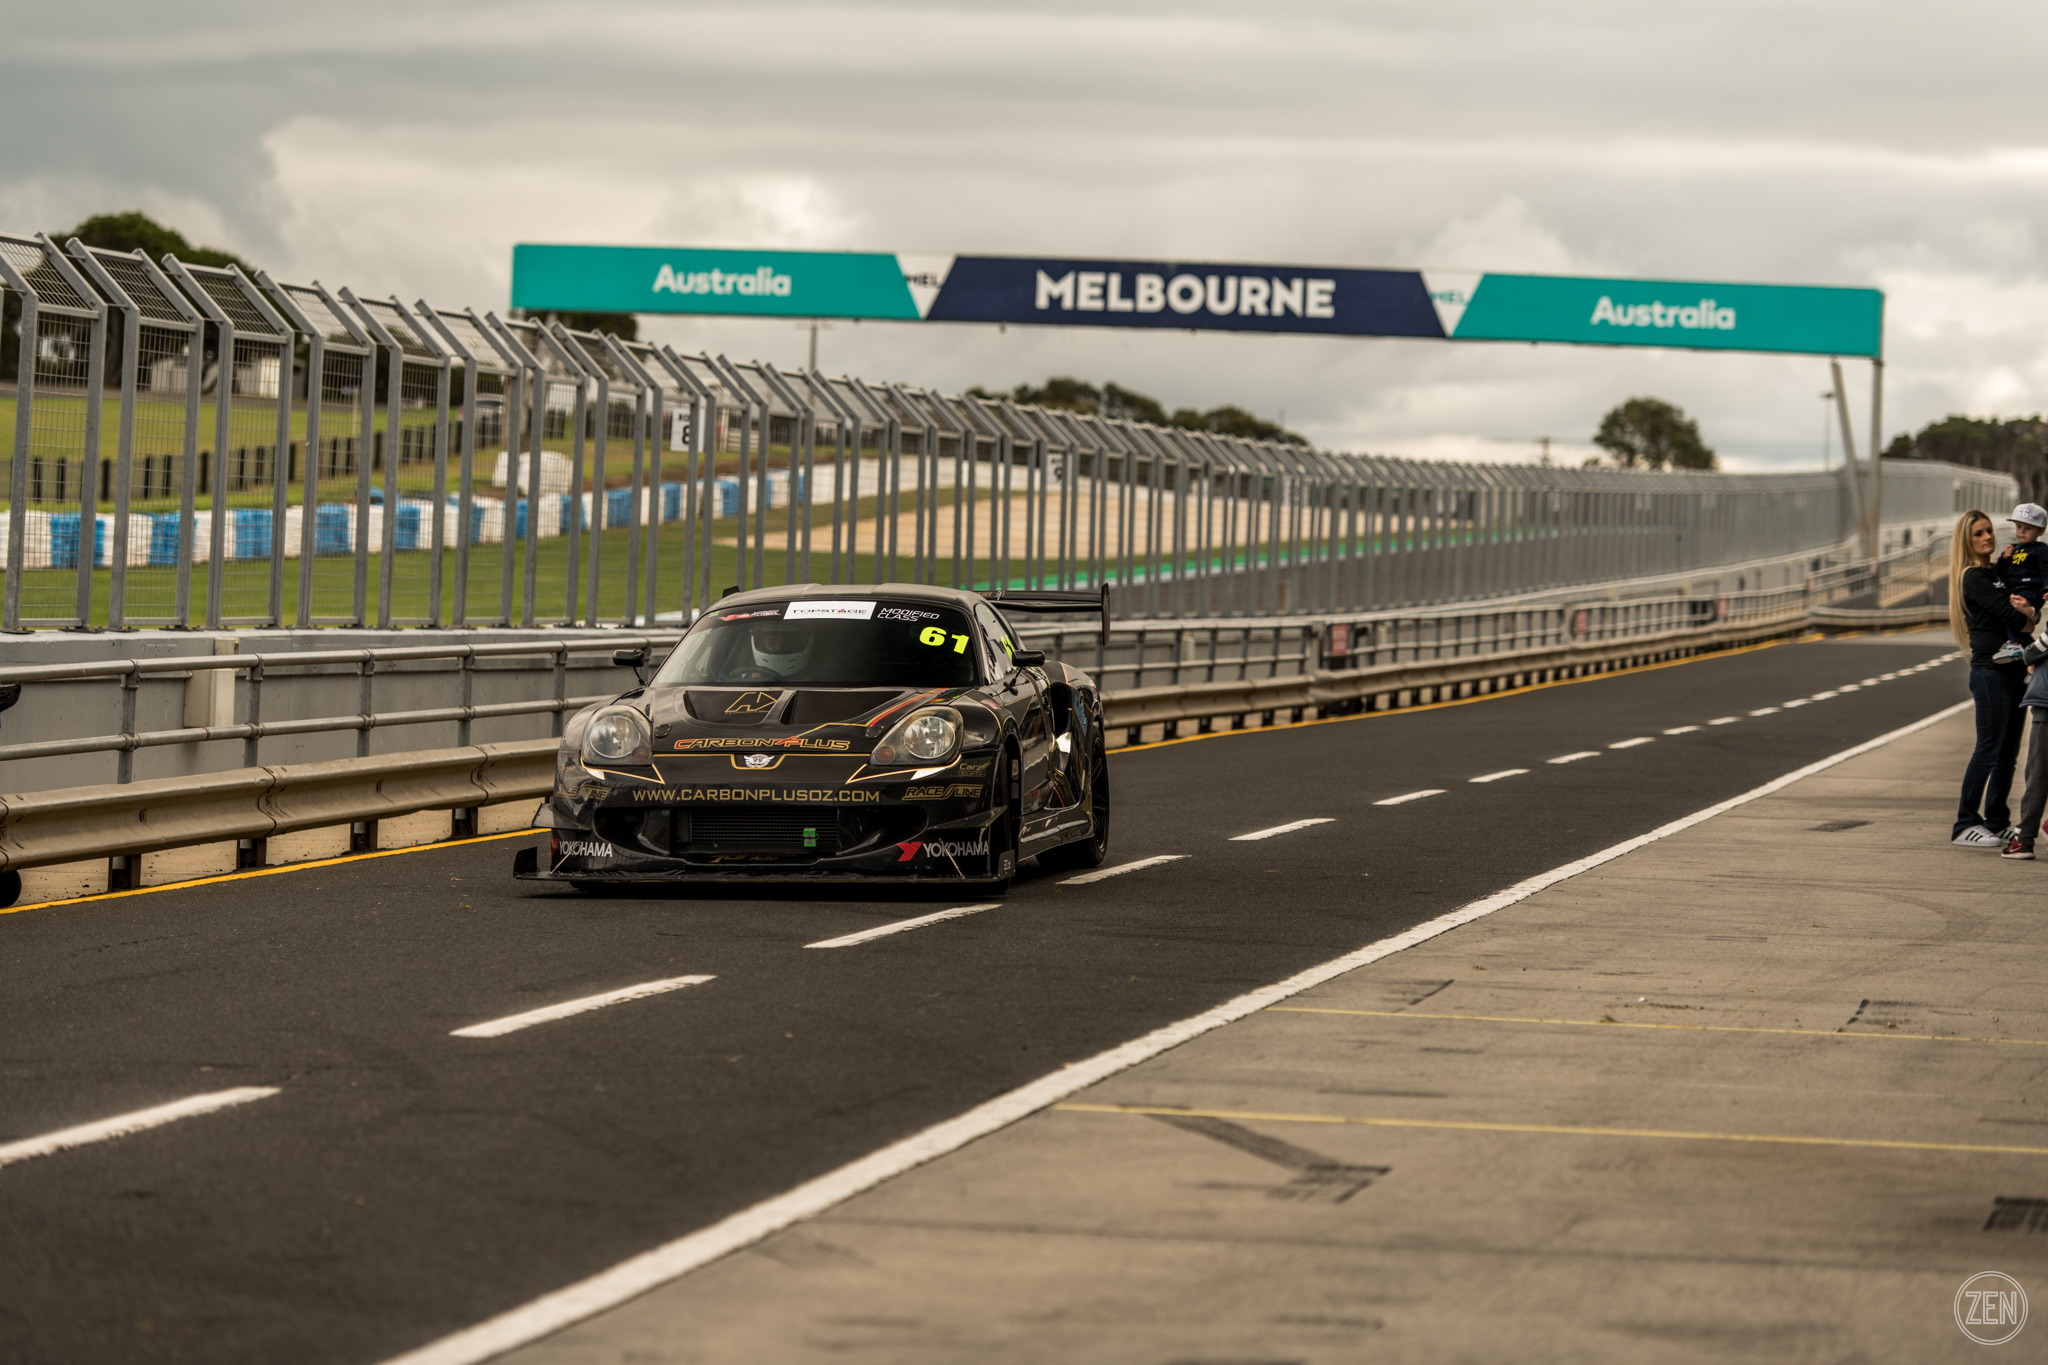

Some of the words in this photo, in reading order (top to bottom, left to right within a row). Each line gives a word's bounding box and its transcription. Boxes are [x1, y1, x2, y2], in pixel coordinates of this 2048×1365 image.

[652, 263, 792, 297] Australia
[1034, 269, 1335, 319] MELBOURNE
[1590, 295, 1736, 330] Australia
[877, 612, 918, 622] CLASS
[880, 607, 940, 620] MODIFIED
[919, 626, 970, 654] 61
[632, 789, 880, 803] WWW.CARBONPLUSOZ.COM
[559, 840, 613, 858] YOKOHAMA
[922, 841, 989, 858] YOKOHAMA
